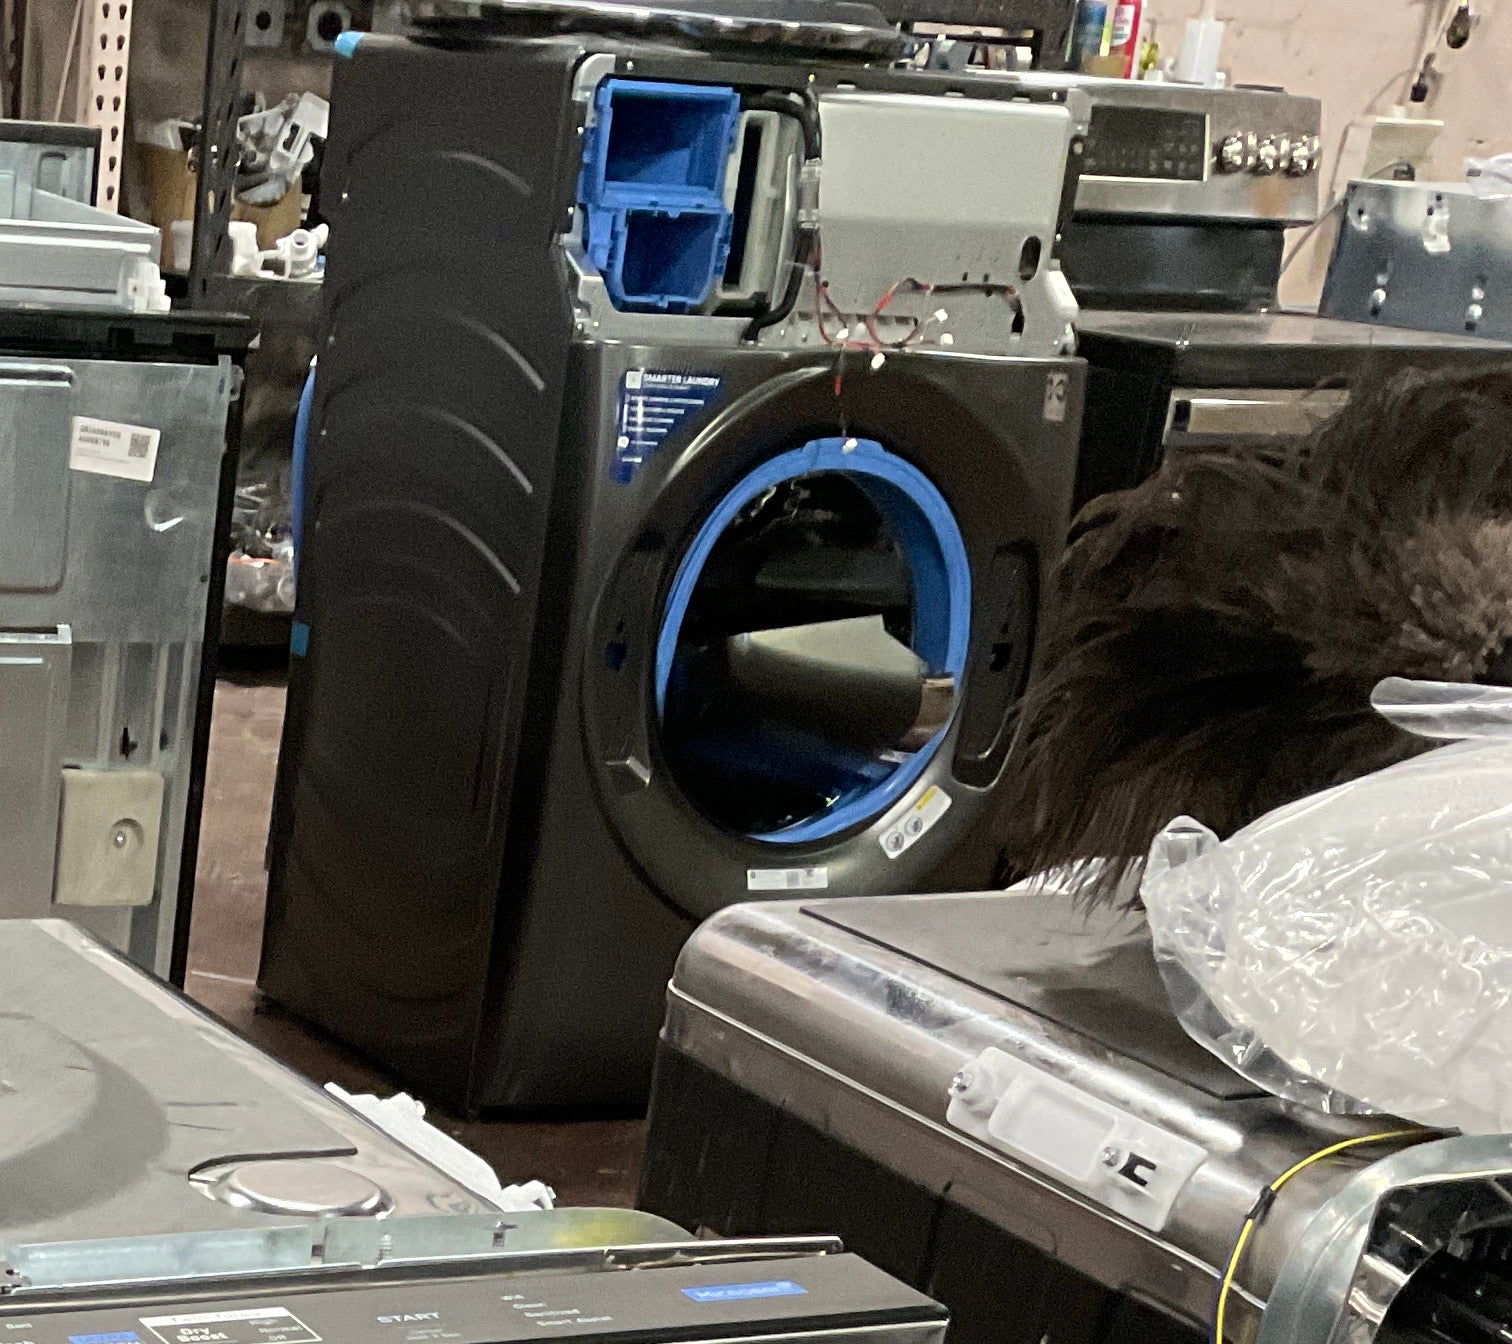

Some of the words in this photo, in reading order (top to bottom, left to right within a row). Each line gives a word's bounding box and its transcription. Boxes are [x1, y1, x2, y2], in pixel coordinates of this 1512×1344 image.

[377, 1312, 440, 1323] START
[179, 1327, 210, 1336] Dry
[176, 1332, 229, 1343] Boost
